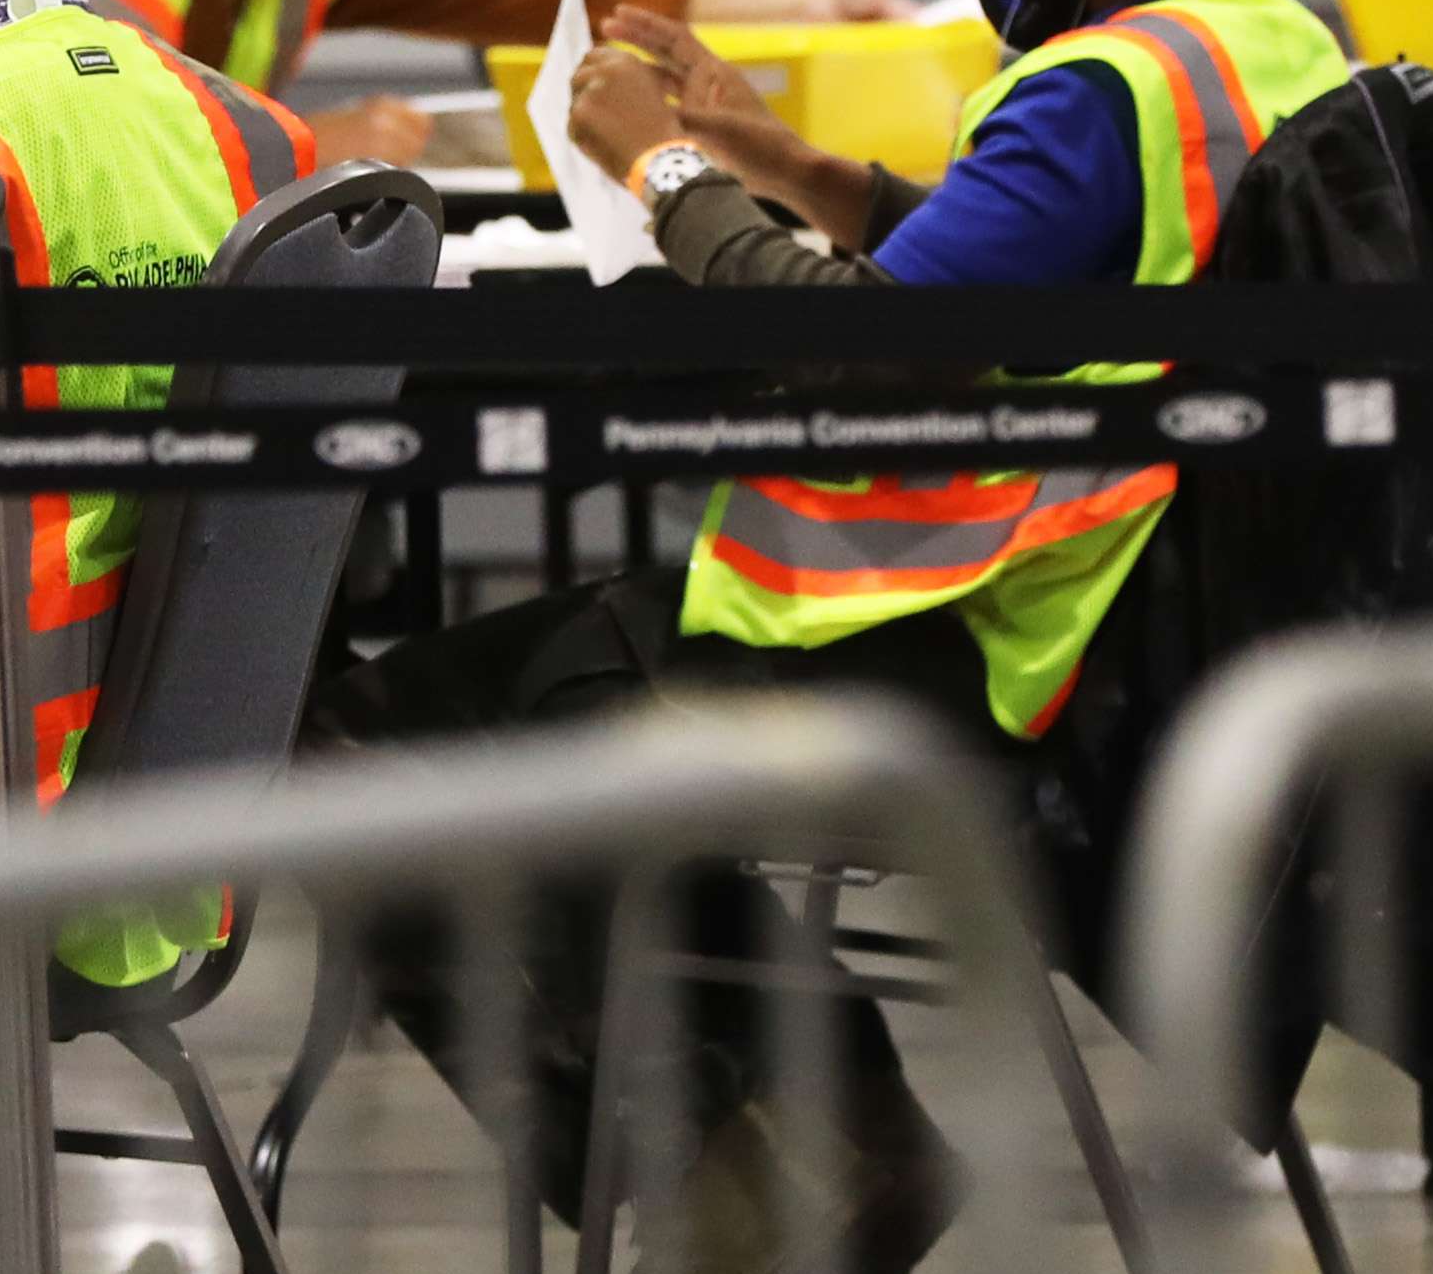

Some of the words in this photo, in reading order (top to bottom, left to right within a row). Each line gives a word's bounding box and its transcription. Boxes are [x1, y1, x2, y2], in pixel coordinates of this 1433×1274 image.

[150, 429, 257, 466] Center
[603, 415, 805, 456] Pennsylvania
[809, 409, 988, 447] Convention
[991, 404, 1098, 441] Center
